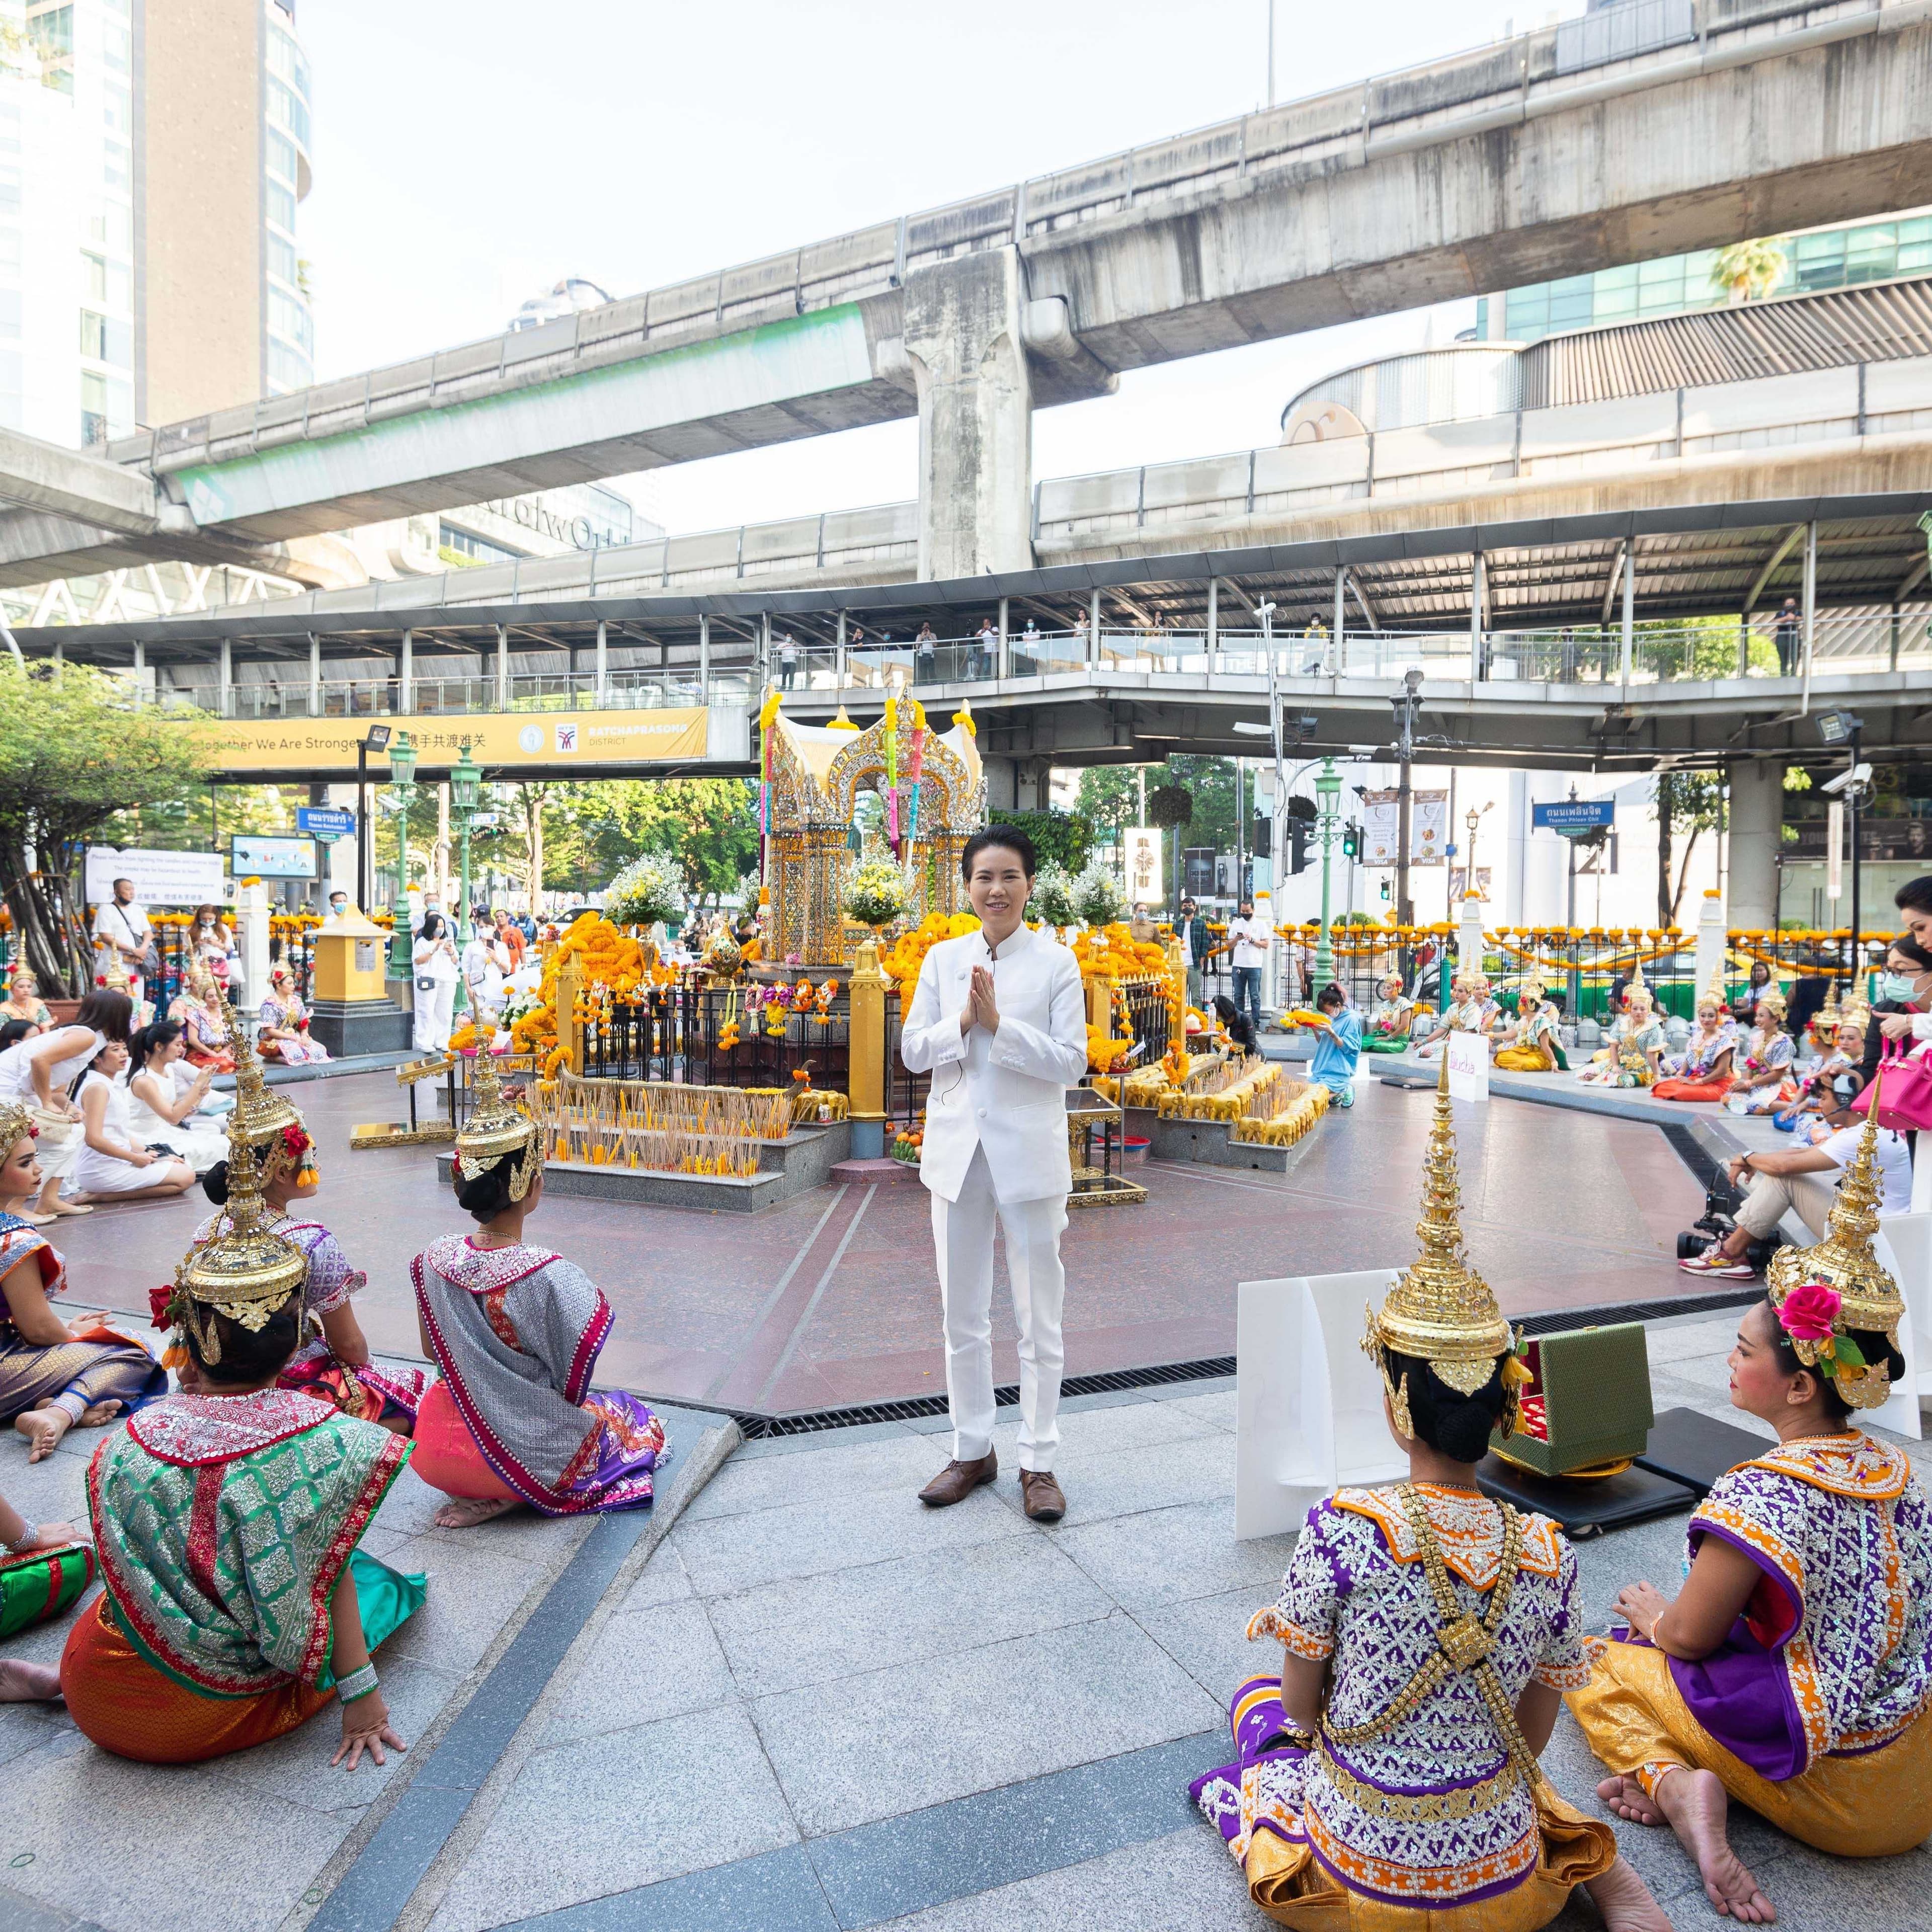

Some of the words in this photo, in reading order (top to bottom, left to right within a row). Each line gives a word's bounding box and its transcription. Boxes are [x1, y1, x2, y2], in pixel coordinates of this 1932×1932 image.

[588, 723, 687, 737] RATCHAPRASONG
[199, 738, 253, 754] ogether
[256, 739, 276, 750] We
[279, 738, 302, 749] Are
[305, 737, 359, 753] Stronge
[589, 737, 626, 746] DISTRICT
[1547, 805, 1601, 817] ถนนเพลินจิต
